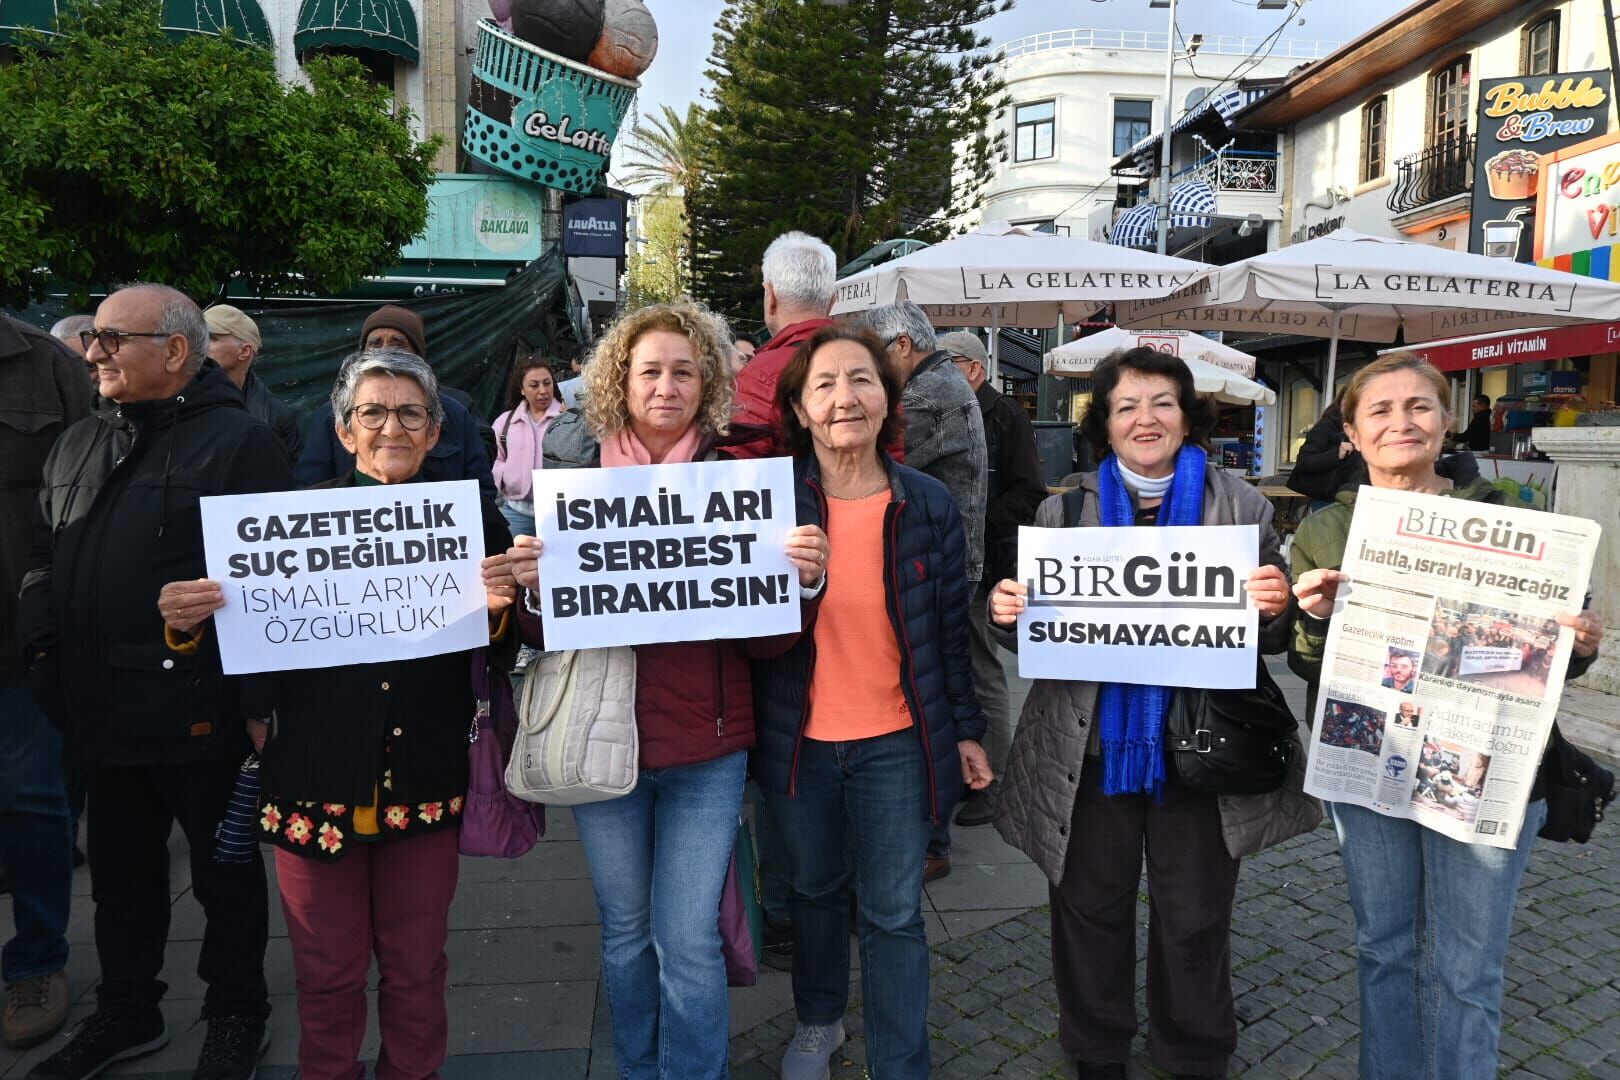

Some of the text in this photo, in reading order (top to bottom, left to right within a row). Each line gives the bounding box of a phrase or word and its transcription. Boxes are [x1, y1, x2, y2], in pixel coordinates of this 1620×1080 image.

[1485, 77, 1606, 117] Bubble
[480, 218, 529, 235] BAKLAVA
[567, 216, 617, 231] LAVAZZA
[979, 271, 1184, 289] LA GELATERIA
[1333, 273, 1557, 302] LA GELATERIA
[1471, 336, 1547, 360] ENERJİ VİTAMİN
[237, 499, 456, 543] GAZETECİLİK
[556, 487, 773, 531] İSMAİL ARI
[228, 533, 469, 579] SUÇ DEĞİLDİR!
[578, 533, 757, 572] SERBEST
[1358, 539, 1570, 601] İnatla, ısrarla yazacağız
[240, 572, 461, 614] İSMAİL ARI'YA
[551, 574, 790, 618] BIRAKILSIN!
[265, 605, 446, 644] ÖZGÜRLÜK!
[1029, 621, 1247, 648] SUSMAYACAK!
[1342, 623, 1415, 649] Gazetecilik yaptım
[1513, 725, 1537, 741] bir
